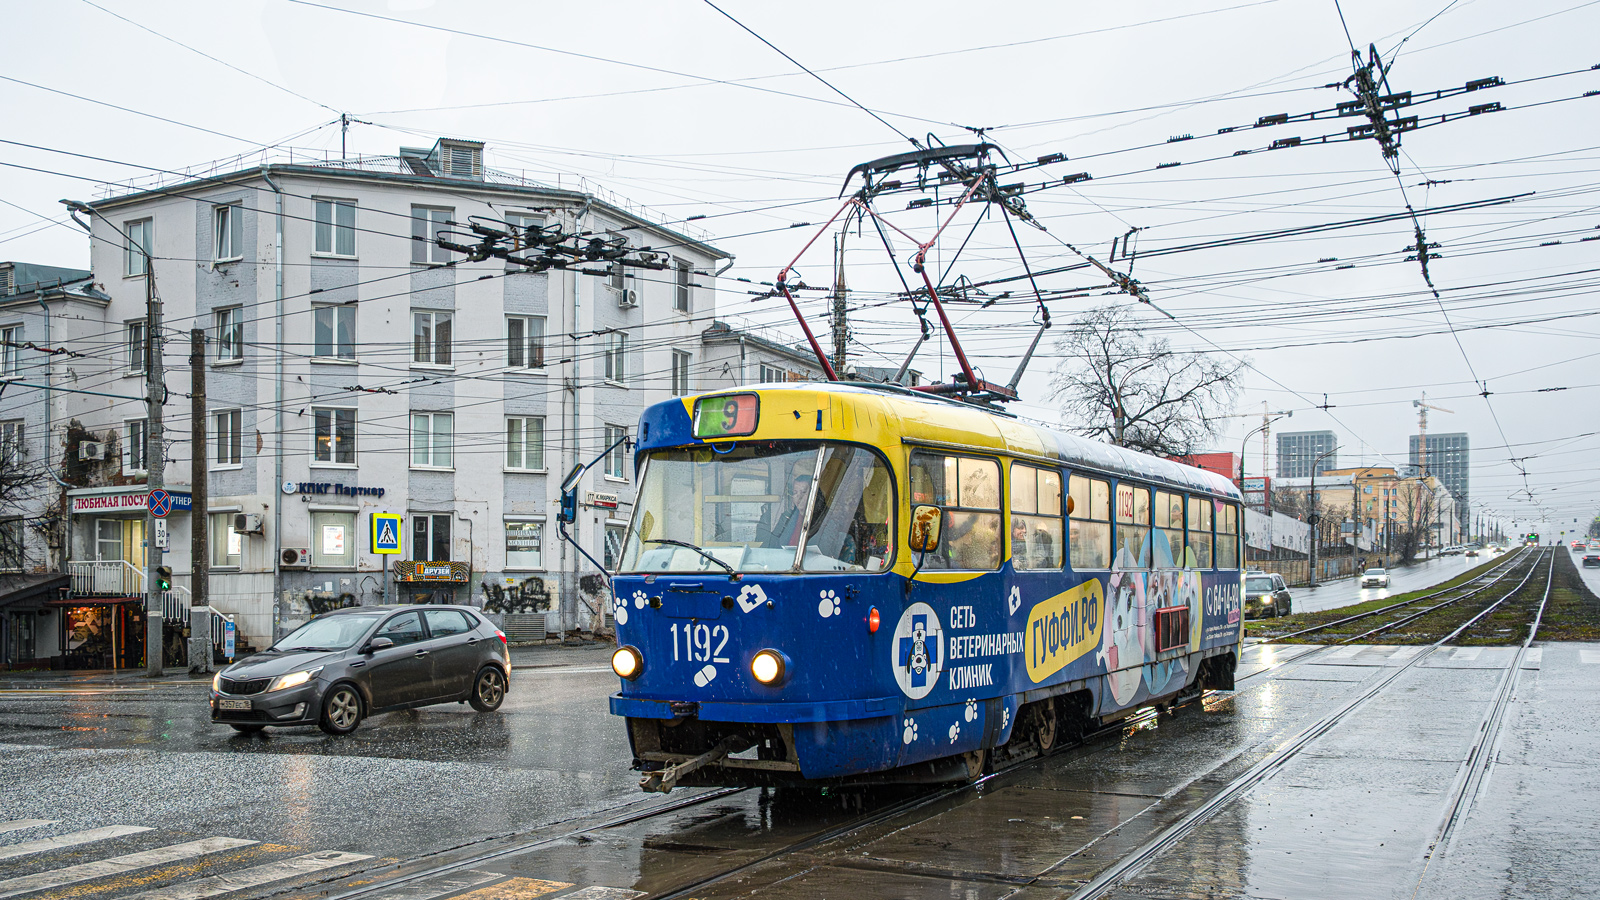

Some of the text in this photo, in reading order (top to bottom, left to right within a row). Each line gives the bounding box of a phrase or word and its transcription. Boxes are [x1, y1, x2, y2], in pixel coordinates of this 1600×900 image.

[721, 400, 738, 430] 9
[75, 494, 149, 510] ЛЮБИМАЯ ПОСУД
[171, 496, 192, 505] РТНЕР
[299, 483, 331, 494] КПКГ
[335, 484, 384, 498] Партнер
[1118, 490, 1133, 517] 1192
[157, 530, 165, 538] 30
[950, 605, 976, 629] СЕТЬ
[670, 623, 730, 663] 1192
[1032, 593, 1099, 669] ГУФФИ.РФ
[950, 631, 1024, 660] ВЕТЕРИНАРНЫХ
[949, 663, 993, 690] КЛИНИК
